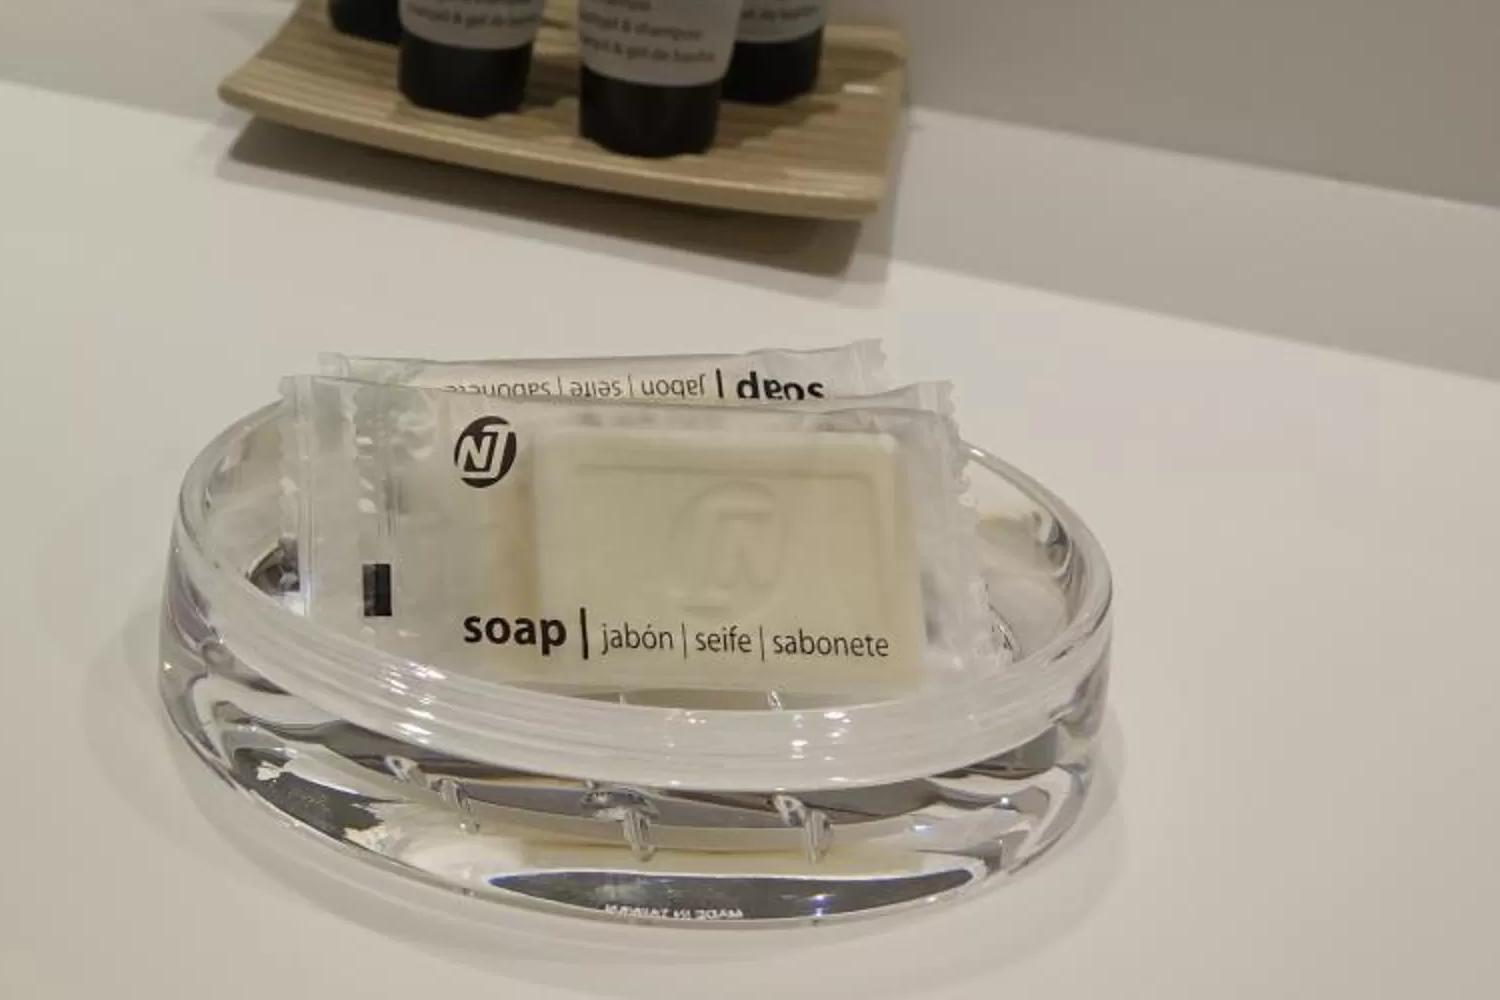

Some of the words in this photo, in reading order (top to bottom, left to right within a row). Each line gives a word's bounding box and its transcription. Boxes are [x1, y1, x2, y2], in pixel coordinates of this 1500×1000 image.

[463, 614, 567, 657] soap
[600, 621, 674, 656] jabón
[695, 623, 751, 654] seife
[772, 626, 890, 658] sabonete
